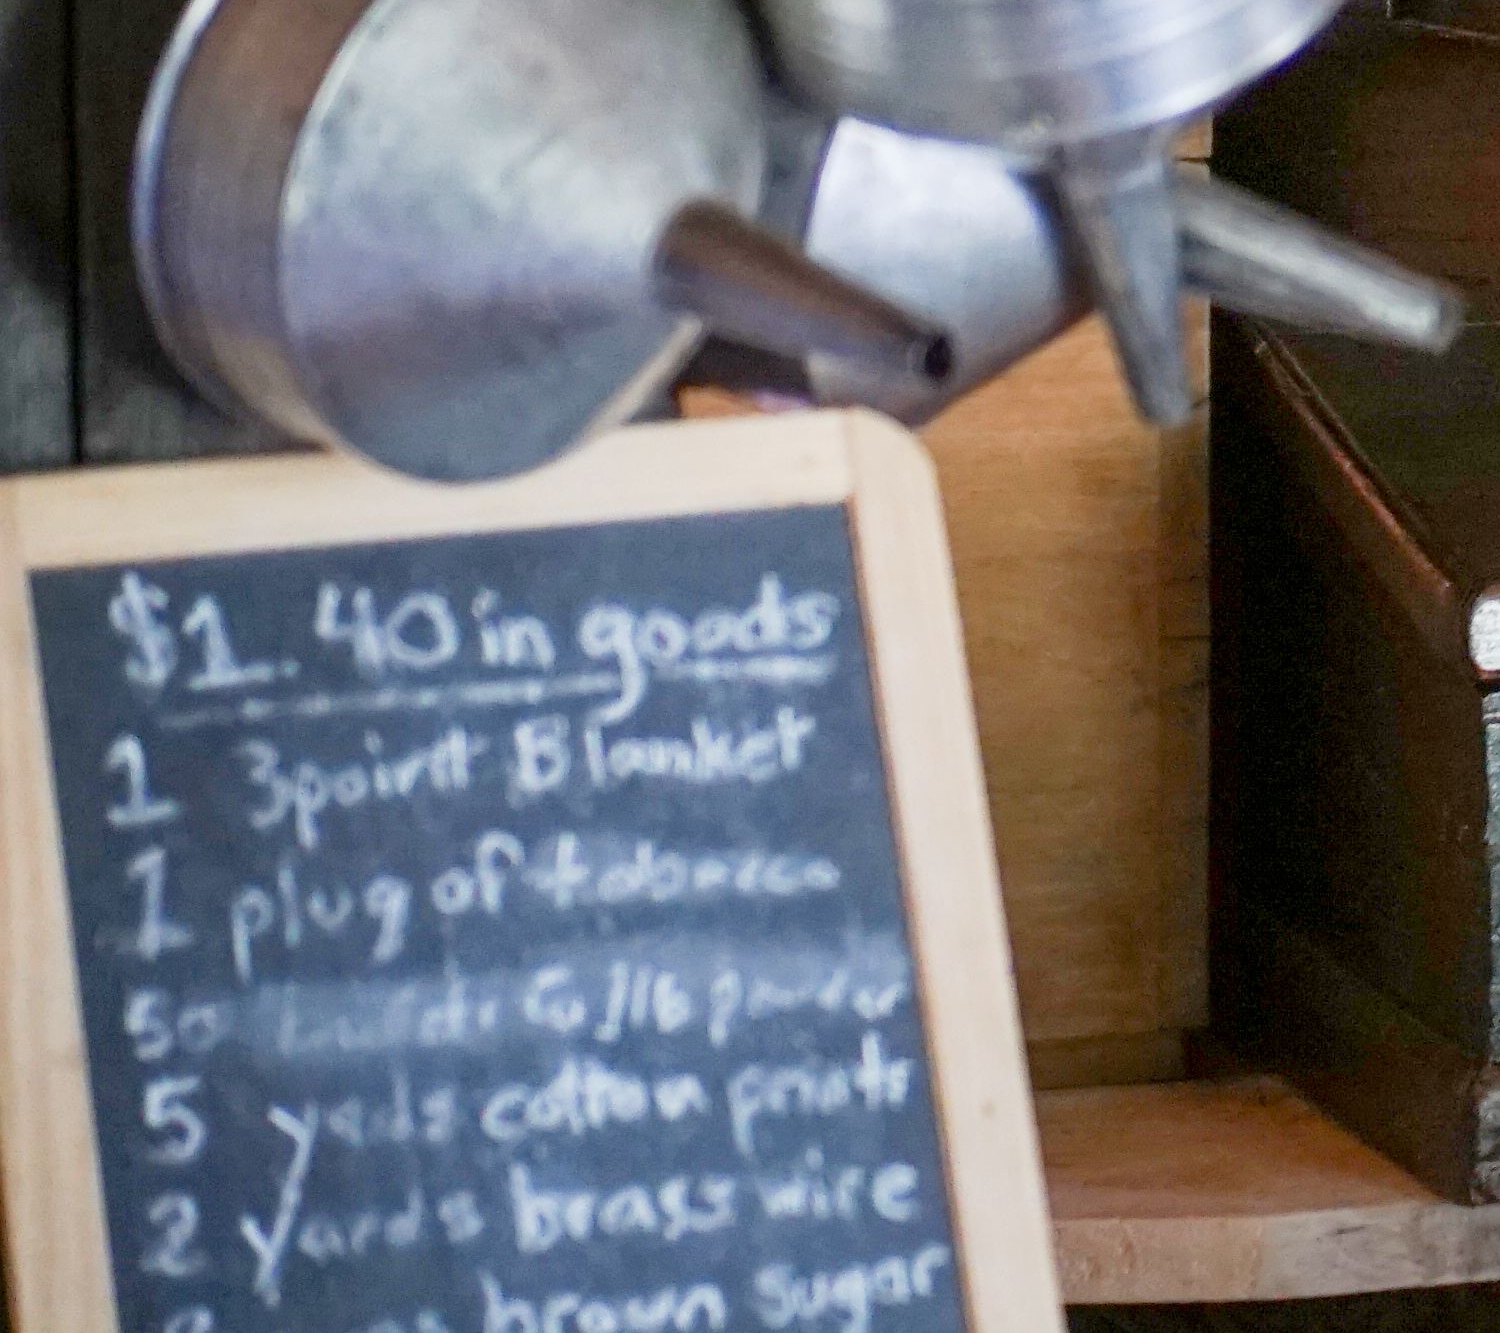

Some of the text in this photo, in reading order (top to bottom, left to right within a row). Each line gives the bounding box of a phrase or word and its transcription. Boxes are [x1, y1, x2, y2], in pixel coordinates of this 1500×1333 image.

[472, 587, 556, 670] in
[578, 570, 841, 726] goods
[230, 857, 413, 984] plug
[430, 830, 526, 916] of
[142, 1075, 207, 1165] 5
[140, 1191, 207, 1278] 2
